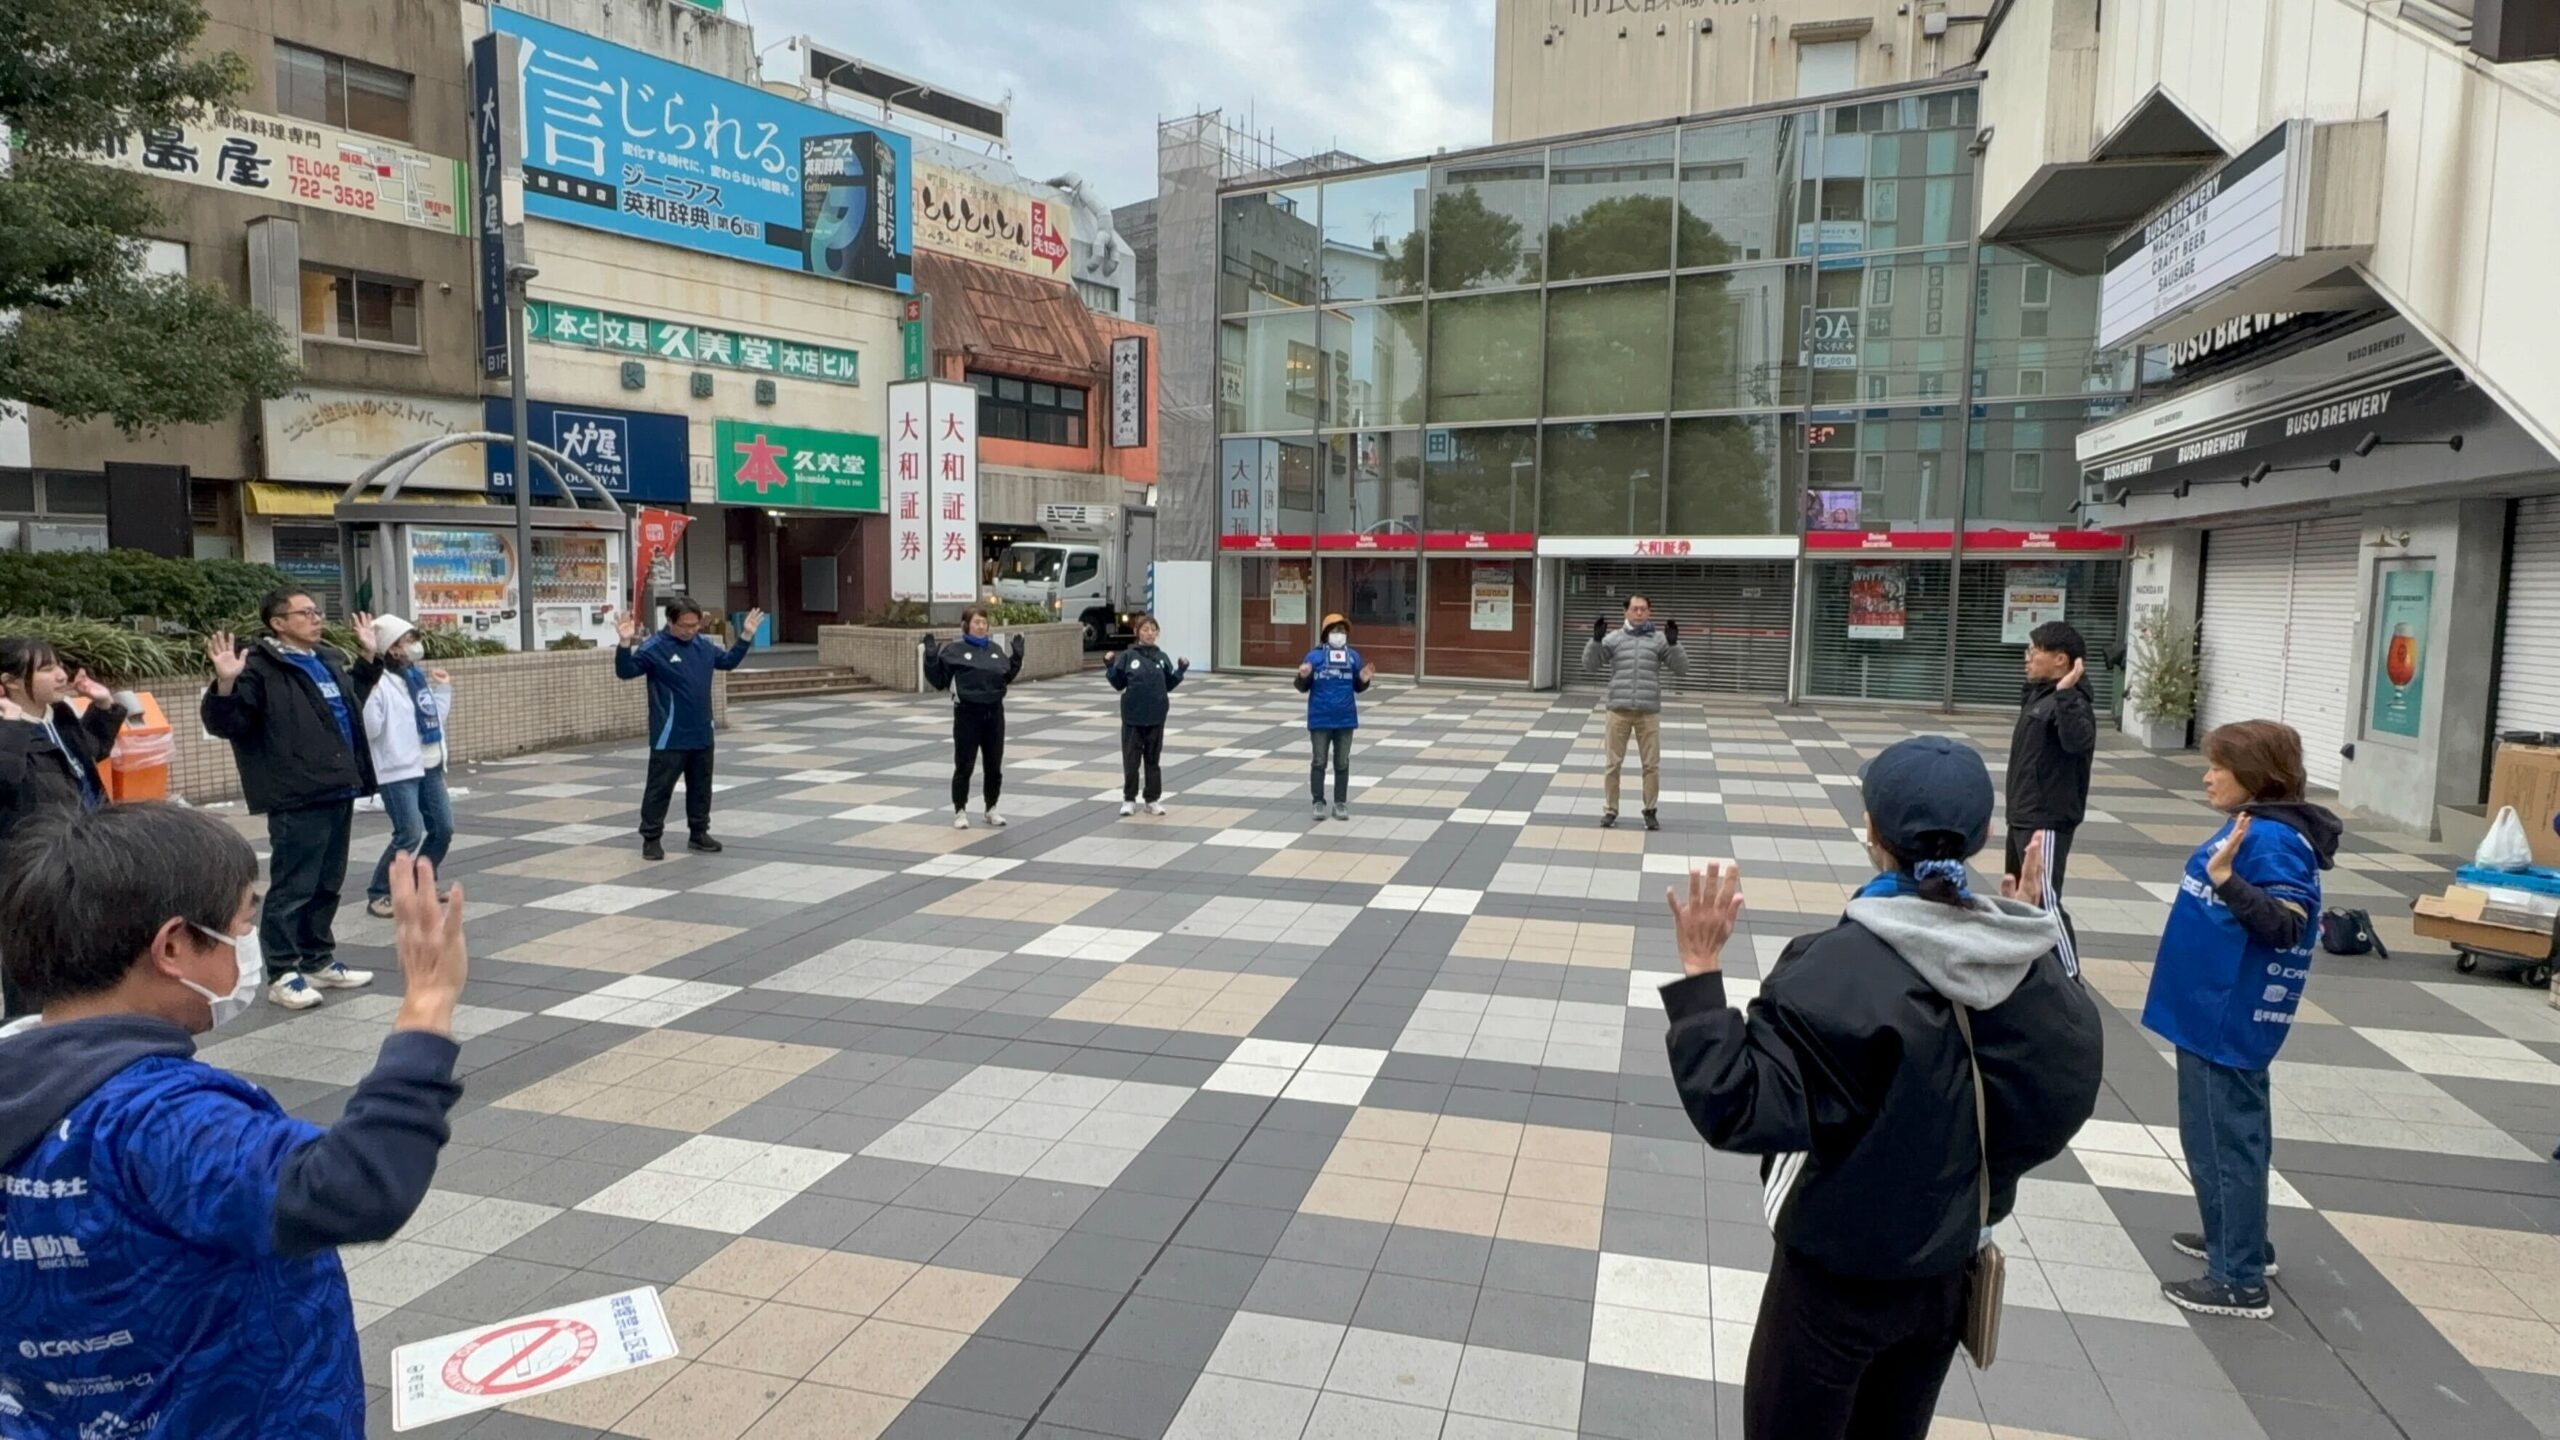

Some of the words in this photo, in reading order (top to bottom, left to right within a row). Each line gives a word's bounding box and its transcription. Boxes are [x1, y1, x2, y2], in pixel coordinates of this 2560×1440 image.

[518, 37, 799, 182] 信じられる。
[482, 87, 501, 234] 大戸屋
[804, 138, 853, 158] ジーニアス
[288, 175, 375, 211] 722-3532
[622, 164, 724, 208] ジーニアス
[2144, 212, 2169, 245] BUSO
[2170, 173, 2222, 226] BREWERY
[2152, 219, 2190, 256] MACHIDA
[2152, 246, 2179, 276] CRAFT
[2183, 229, 2206, 257] BEER
[2158, 257, 2196, 293] SAUSAGE
[908, 303, 919, 318] 本
[487, 354, 507, 371] B1F
[658, 324, 773, 370] 久美堂
[783, 350, 854, 378] 本店ビル
[2167, 332, 2212, 369] BUSO
[2347, 346, 2367, 363] BUSO
[2368, 333, 2406, 357] BREWERY
[2285, 410, 2319, 437] BUSO
[2320, 391, 2391, 429] BREWERY
[563, 421, 621, 461] 大戸屋
[2178, 443, 2200, 464] BUSO
[2201, 430, 2248, 459] BREWERY
[733, 434, 788, 493] 本
[793, 450, 865, 475] 久美堂
[2104, 463, 2120, 481] BUSO
[2120, 456, 2153, 478] BREWERY
[899, 411, 921, 561] 大和証券
[940, 412, 966, 562] 大和証券
[1634, 540, 1691, 555] 大和証券
